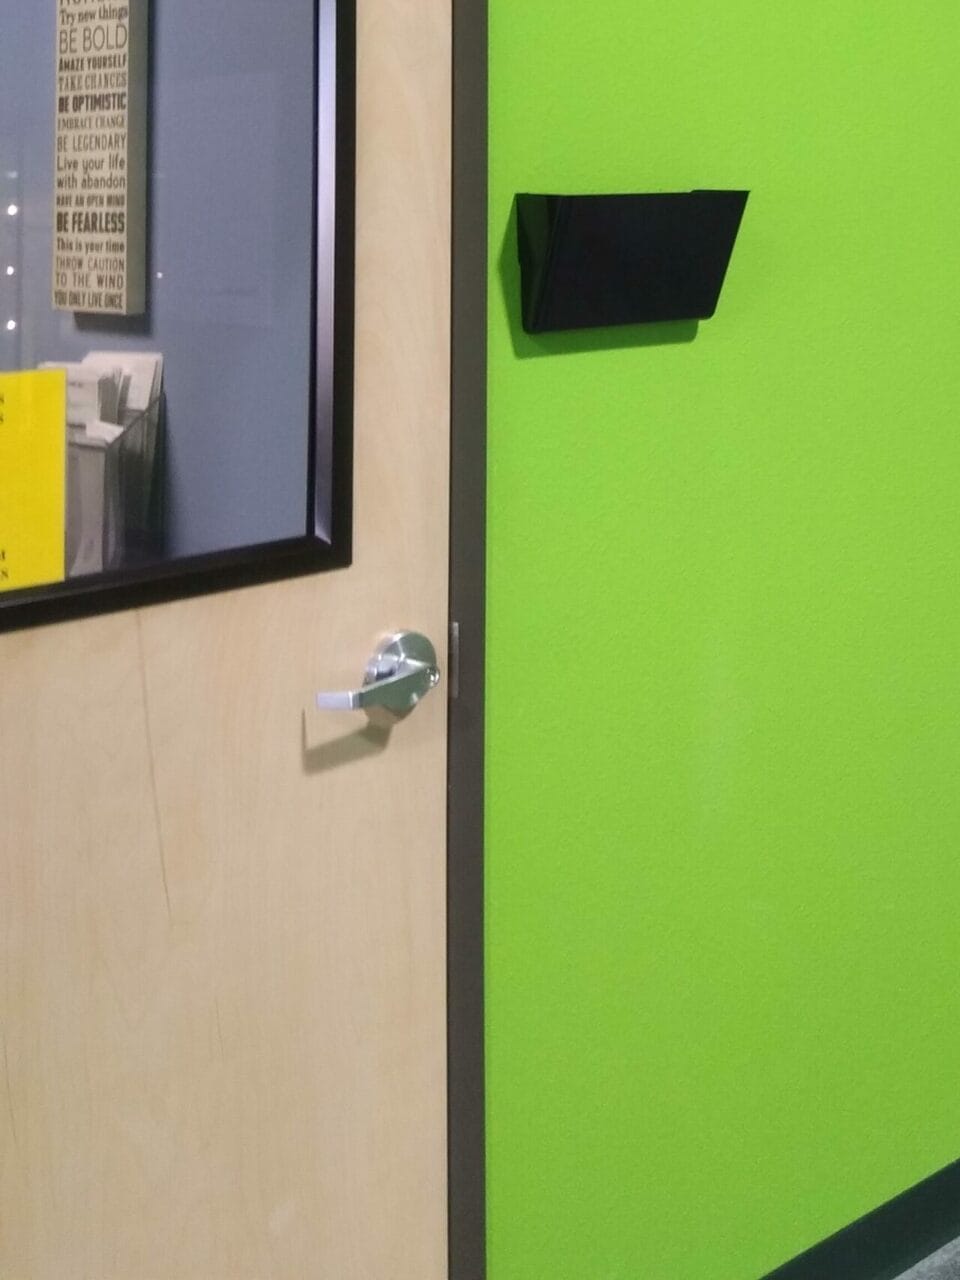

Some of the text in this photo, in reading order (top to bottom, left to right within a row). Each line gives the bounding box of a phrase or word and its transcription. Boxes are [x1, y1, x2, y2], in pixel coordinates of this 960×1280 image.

[60, 5, 128, 27] Try new things
[60, 25, 127, 54] BE BOLD
[87, 52, 126, 70] YOURSELF
[59, 71, 126, 91] TAKE CHANCES
[59, 93, 126, 113] BE OPTIMISTIC
[58, 133, 125, 152] BE LEGENDARY
[58, 154, 125, 174] Live your life
[57, 174, 125, 189] with abandon
[57, 212, 125, 233] BE FEARLESS
[58, 239, 124, 254] This is your time
[56, 257, 124, 272] THROW CAUTION
[56, 273, 123, 289] TO THE WIND
